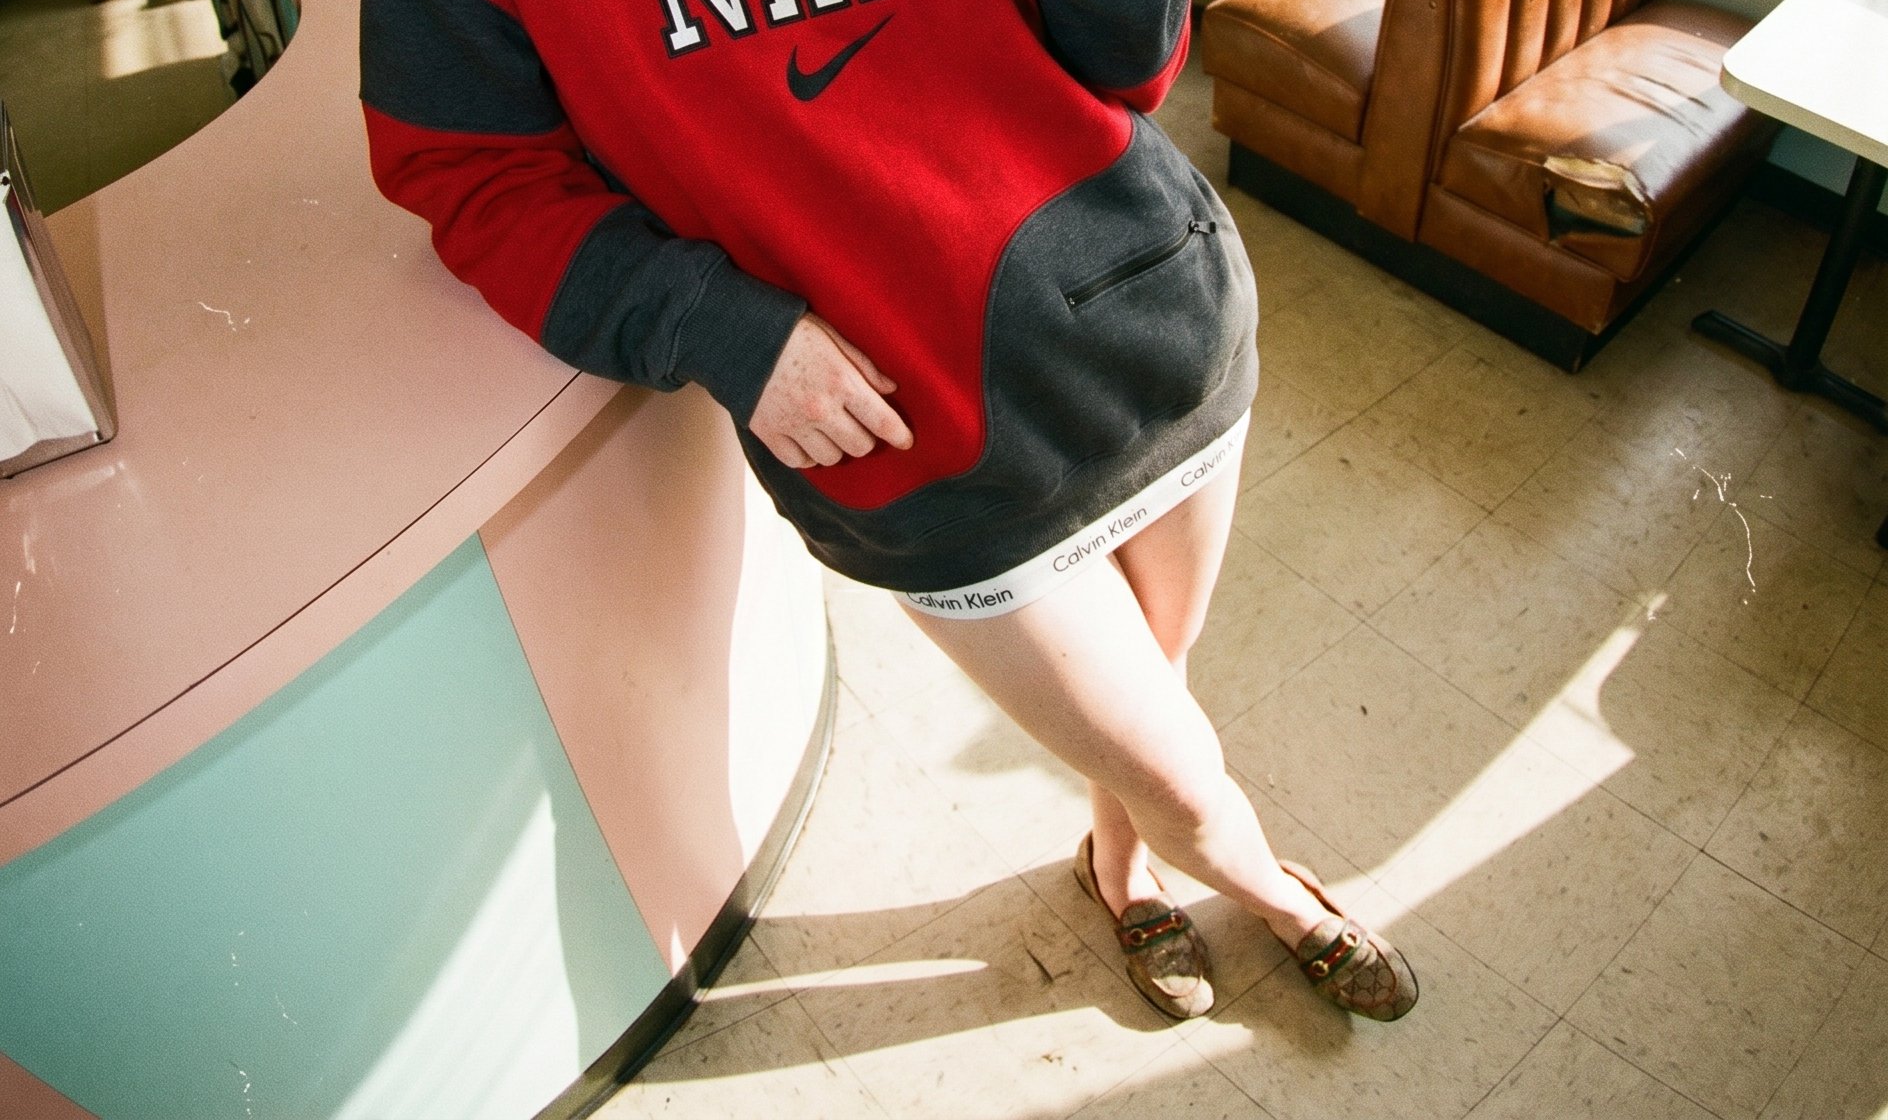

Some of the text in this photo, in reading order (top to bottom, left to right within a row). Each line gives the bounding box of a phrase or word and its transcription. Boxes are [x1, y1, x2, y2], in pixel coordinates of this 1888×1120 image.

[1181, 449, 1225, 486] Calvin
[1053, 508, 1147, 572] Calvin Klein
[964, 588, 1013, 610] Klein
